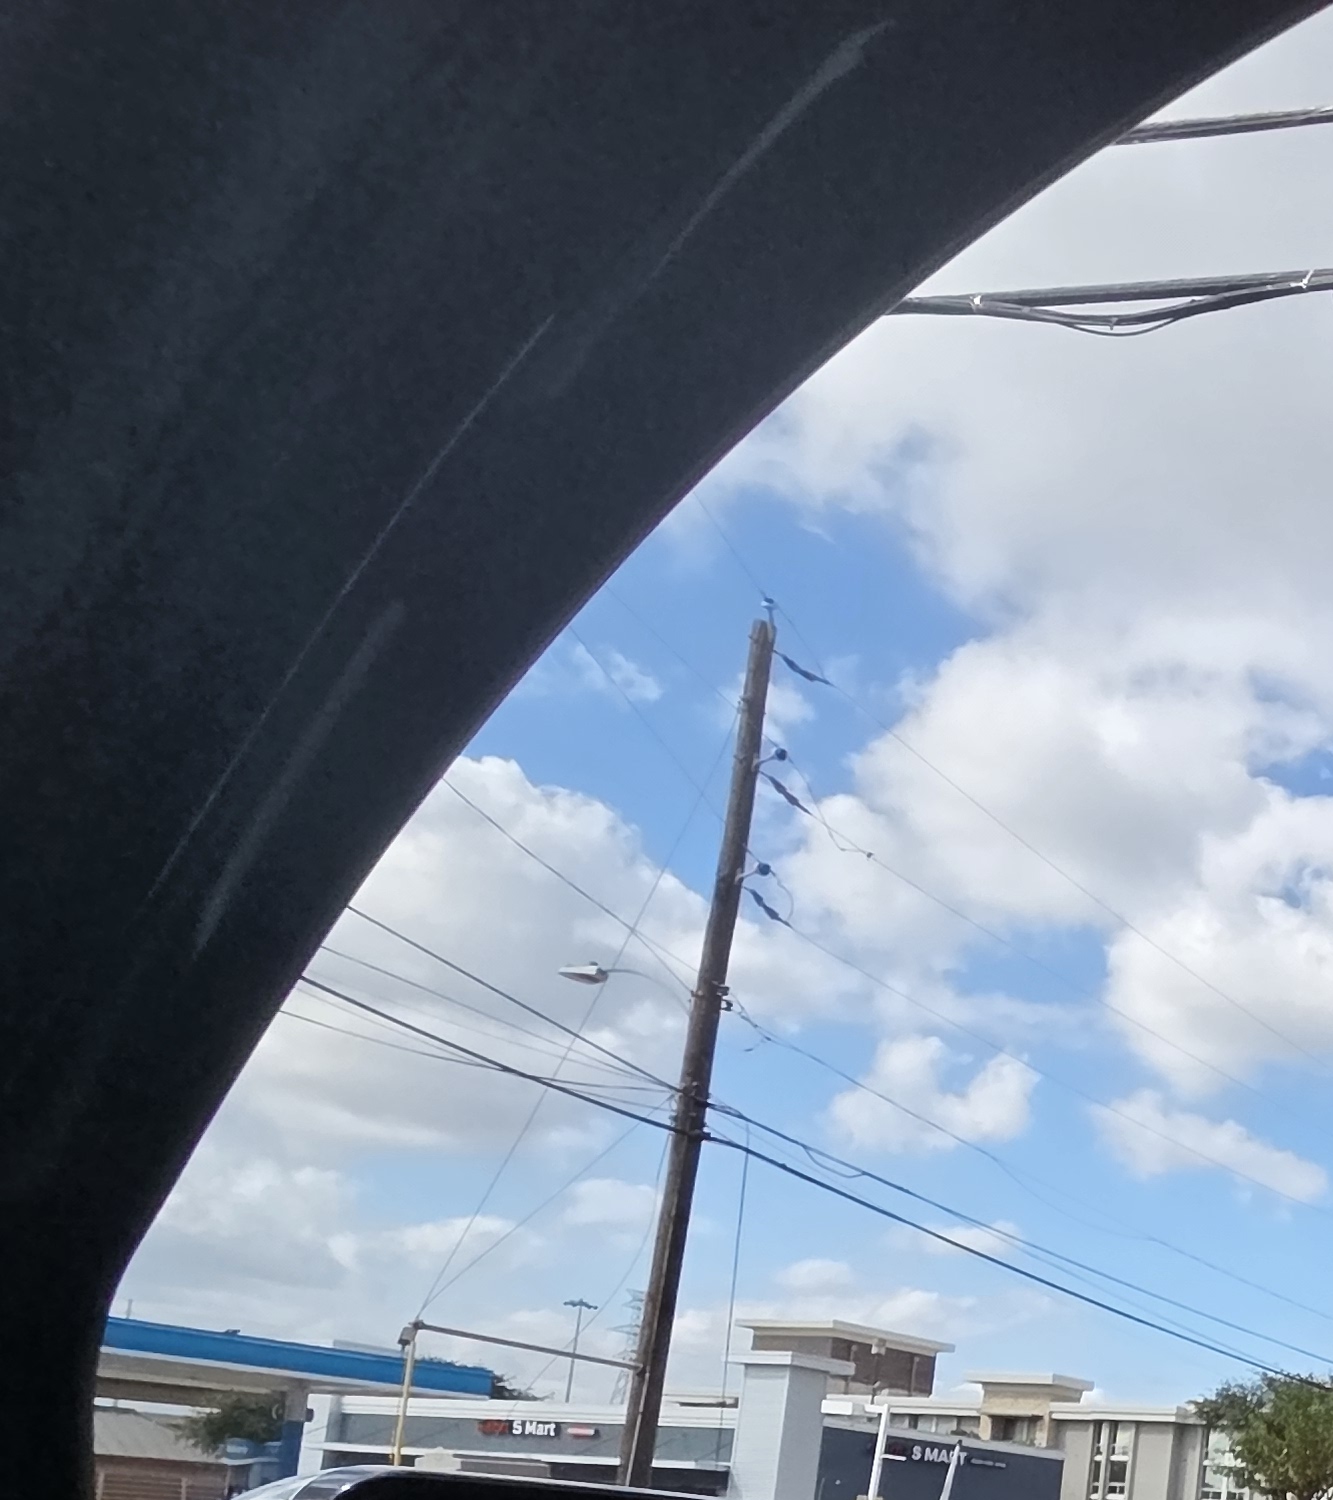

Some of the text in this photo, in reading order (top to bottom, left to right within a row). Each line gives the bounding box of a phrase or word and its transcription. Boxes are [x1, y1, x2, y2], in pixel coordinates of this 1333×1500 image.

[512, 1420, 522, 1435] S
[525, 1421, 556, 1437] Mart
[911, 1445, 923, 1461] S
